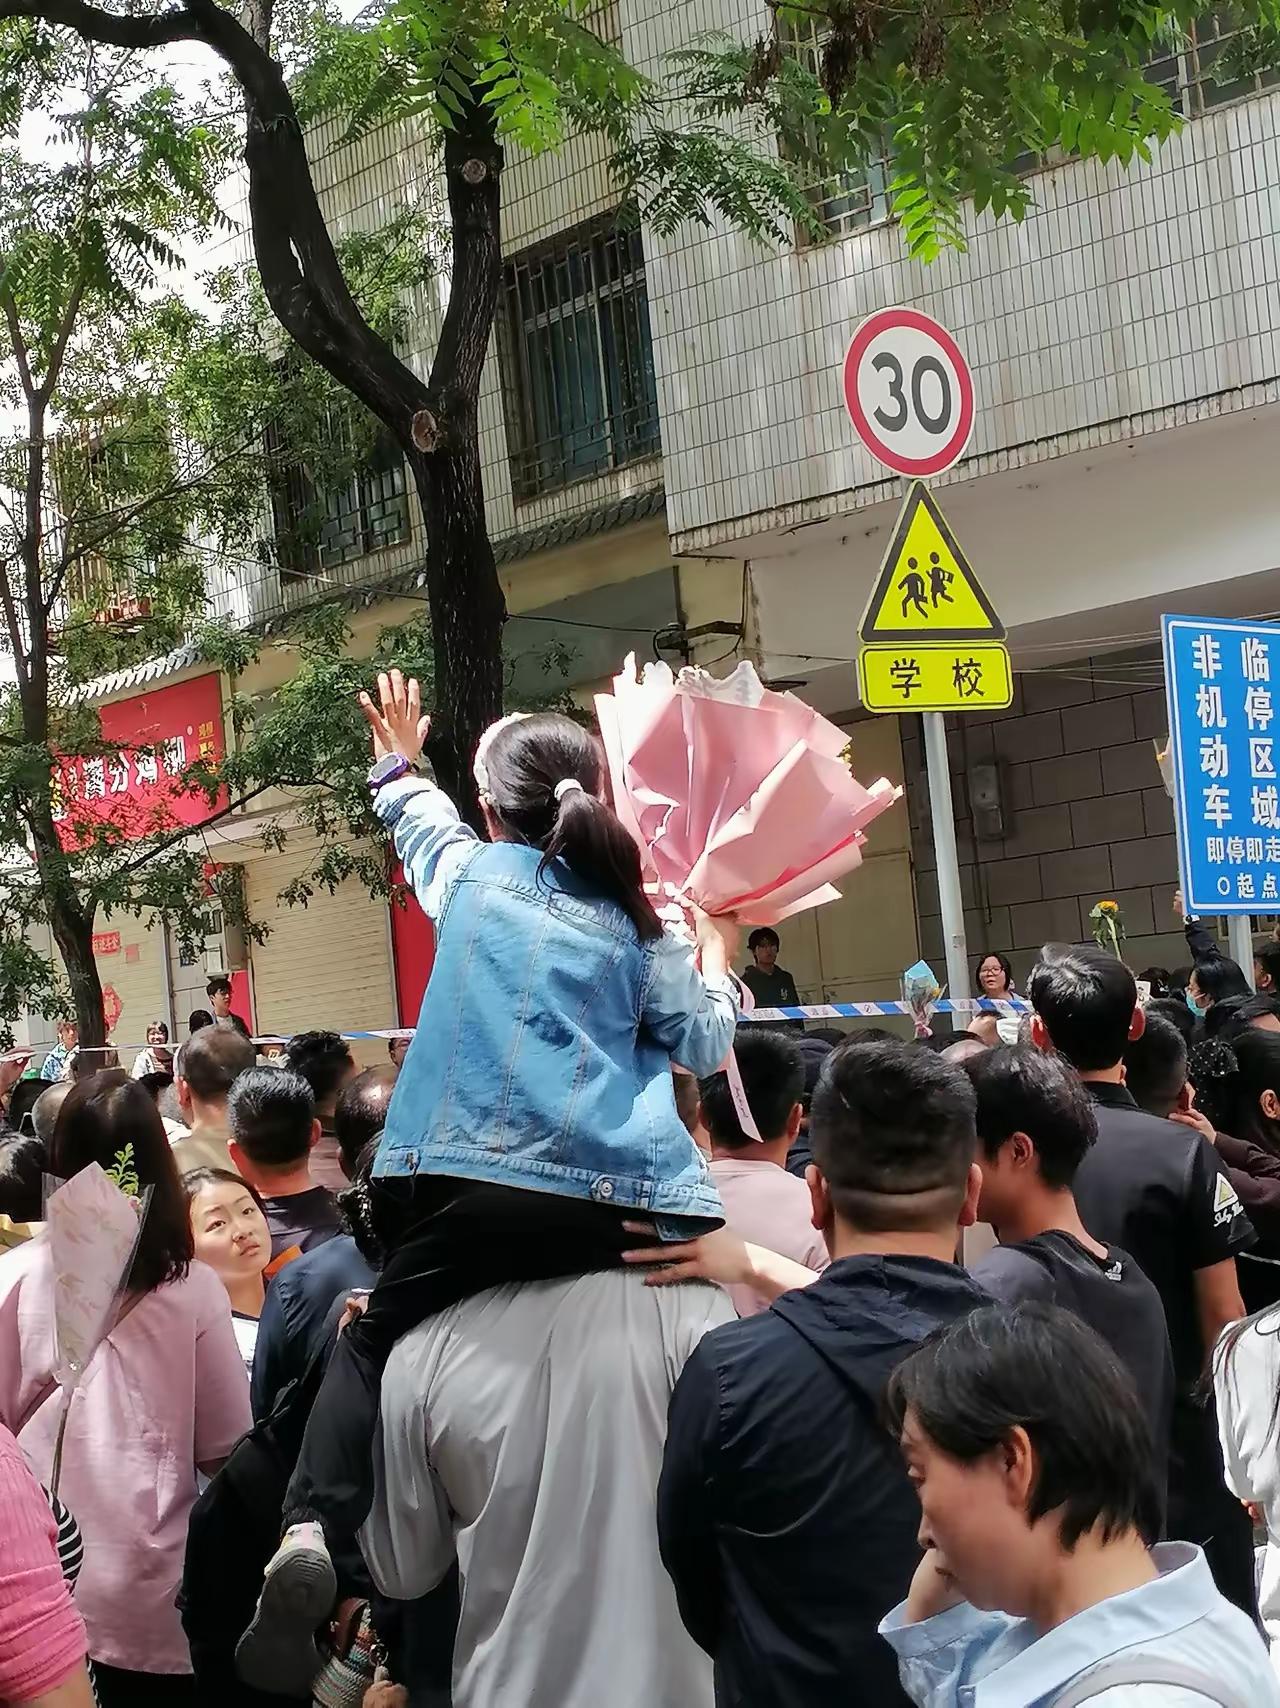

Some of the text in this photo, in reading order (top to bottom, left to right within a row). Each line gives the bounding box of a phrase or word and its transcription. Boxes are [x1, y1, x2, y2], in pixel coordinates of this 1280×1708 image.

[871, 351, 952, 435] 30
[889, 656, 986, 699] 学校
[1191, 634, 1233, 830] 非机动车
[1240, 637, 1280, 830] 临停区域
[1206, 835, 1280, 866] 即停即走
